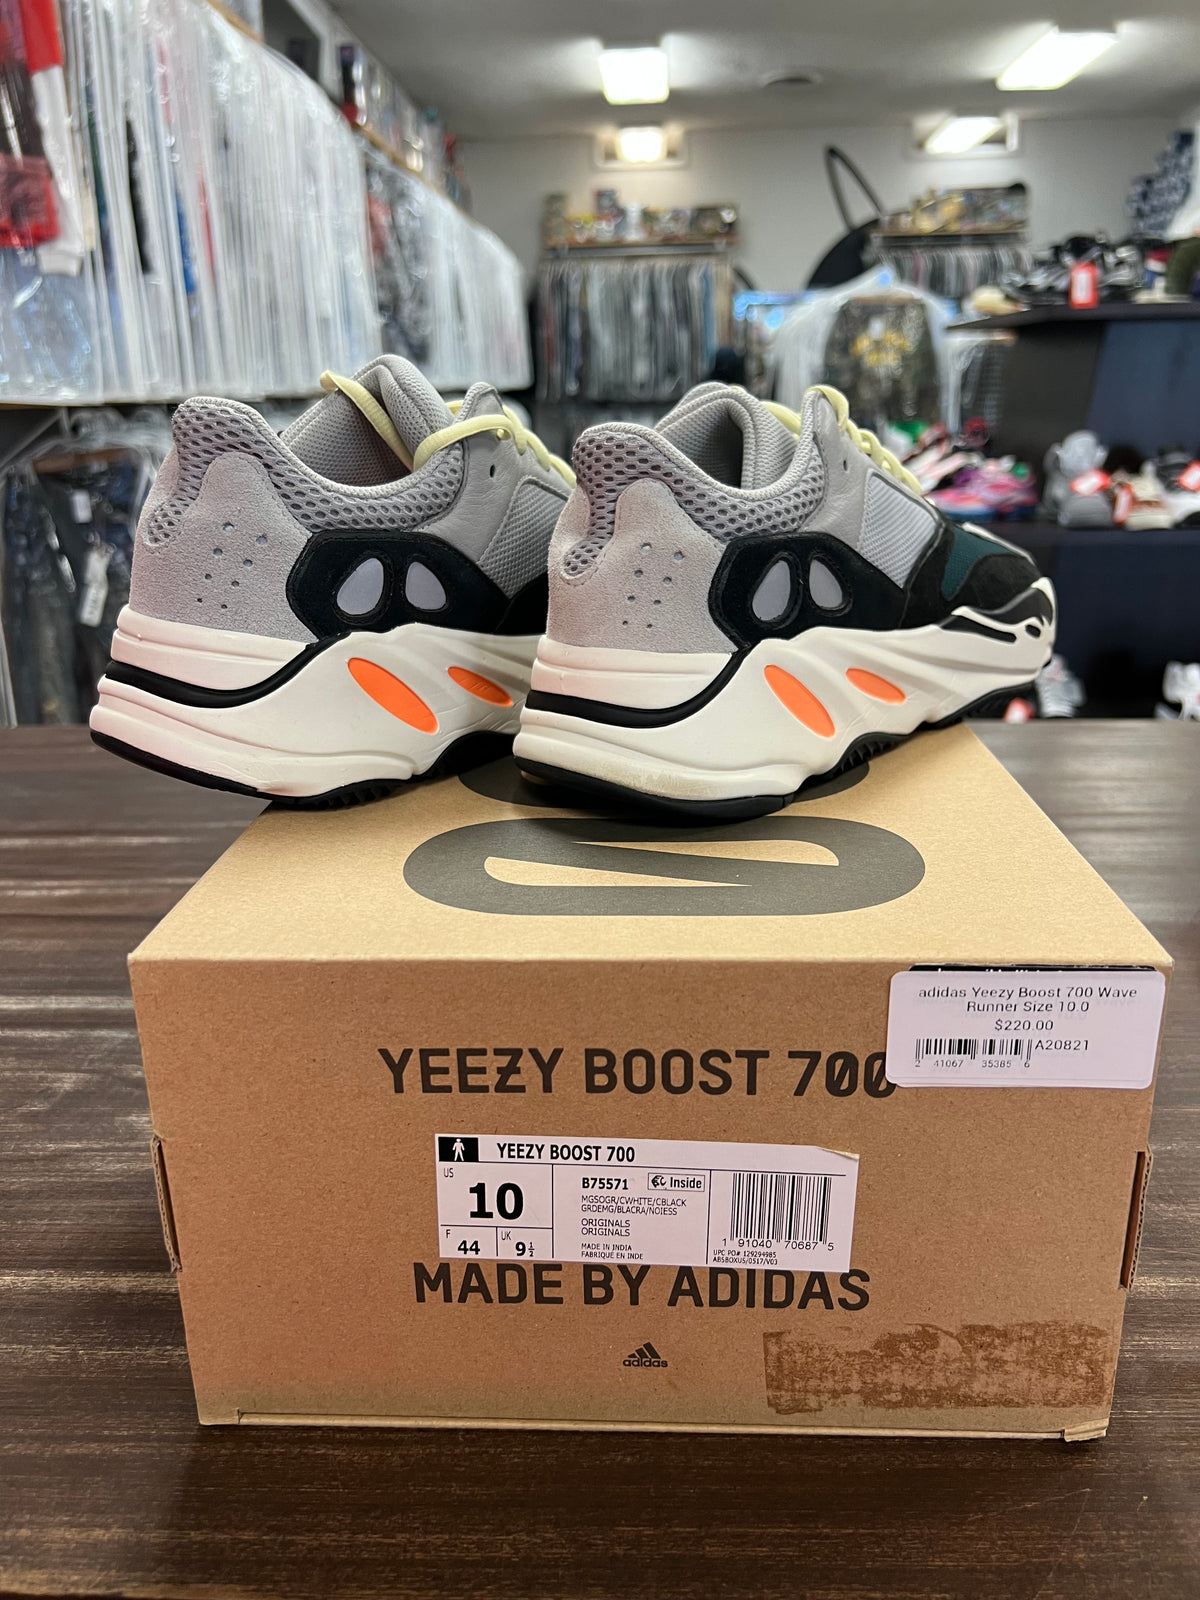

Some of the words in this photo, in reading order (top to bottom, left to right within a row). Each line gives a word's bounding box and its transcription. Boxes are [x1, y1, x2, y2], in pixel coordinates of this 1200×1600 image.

[919, 986, 966, 998] adidas
[972, 987, 1014, 1001] Yeezy
[1018, 987, 1061, 998] Boost
[1065, 987, 1093, 998] 700
[1098, 987, 1137, 998] Wave
[967, 1001, 1018, 1012] Runner
[1023, 1001, 1053, 1012] Size
[1059, 1001, 1089, 1012] 10.0
[994, 1019, 1054, 1032] $220.00
[1034, 1040, 1089, 1050] A20821
[378, 1047, 564, 1094] YEEZY
[586, 1048, 769, 1096] BOOST
[788, 1050, 896, 1099] 700
[497, 1143, 544, 1159] YEEZY
[550, 1145, 602, 1160] BOOST
[606, 1146, 635, 1162] 700
[444, 1168, 454, 1178] US
[582, 1178, 628, 1190] B75571
[670, 1178, 702, 1189] Inside
[469, 1182, 524, 1220] 10
[581, 1218, 630, 1228] ORIGINALS
[446, 1230, 450, 1238] F
[501, 1231, 512, 1240] UK
[581, 1227, 630, 1236] ORIGINALS
[458, 1240, 480, 1255] 44
[738, 1239, 772, 1248] 91040
[784, 1240, 818, 1250] 70687
[828, 1242, 834, 1251] 5
[581, 1252, 614, 1260] FABRIQUE
[627, 1252, 644, 1260] INDE
[413, 1262, 564, 1304] MADE
[584, 1264, 651, 1306] BY
[667, 1266, 870, 1312] ADIDAS
[623, 1357, 668, 1368] adidas
